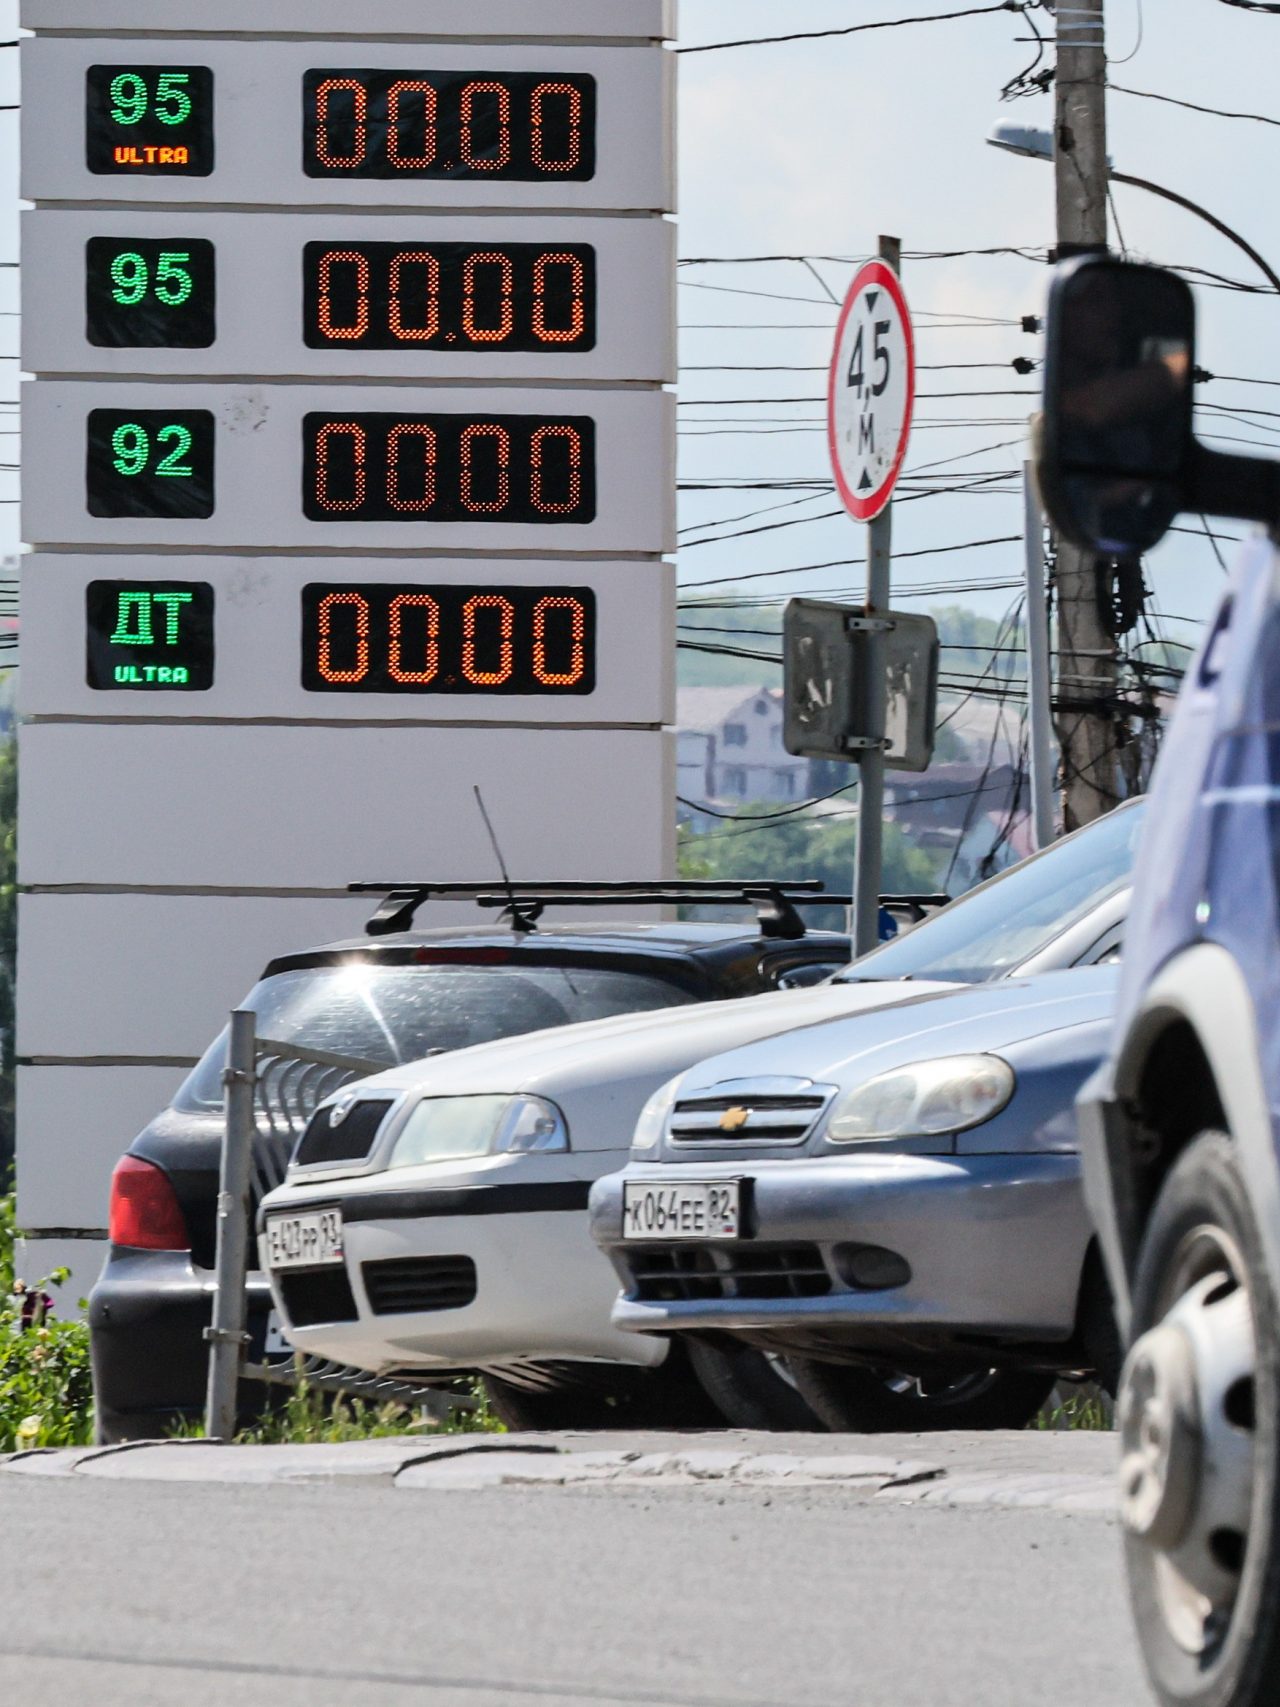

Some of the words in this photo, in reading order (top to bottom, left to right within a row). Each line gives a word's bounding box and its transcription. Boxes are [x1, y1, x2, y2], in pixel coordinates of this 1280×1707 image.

[110, 73, 192, 125] 95
[113, 146, 189, 165] ULTRA
[110, 251, 193, 306] 95
[318, 251, 584, 341] 00.00
[111, 423, 193, 476] 92
[110, 592, 193, 645] ДТ
[114, 665, 189, 683] ULTRA
